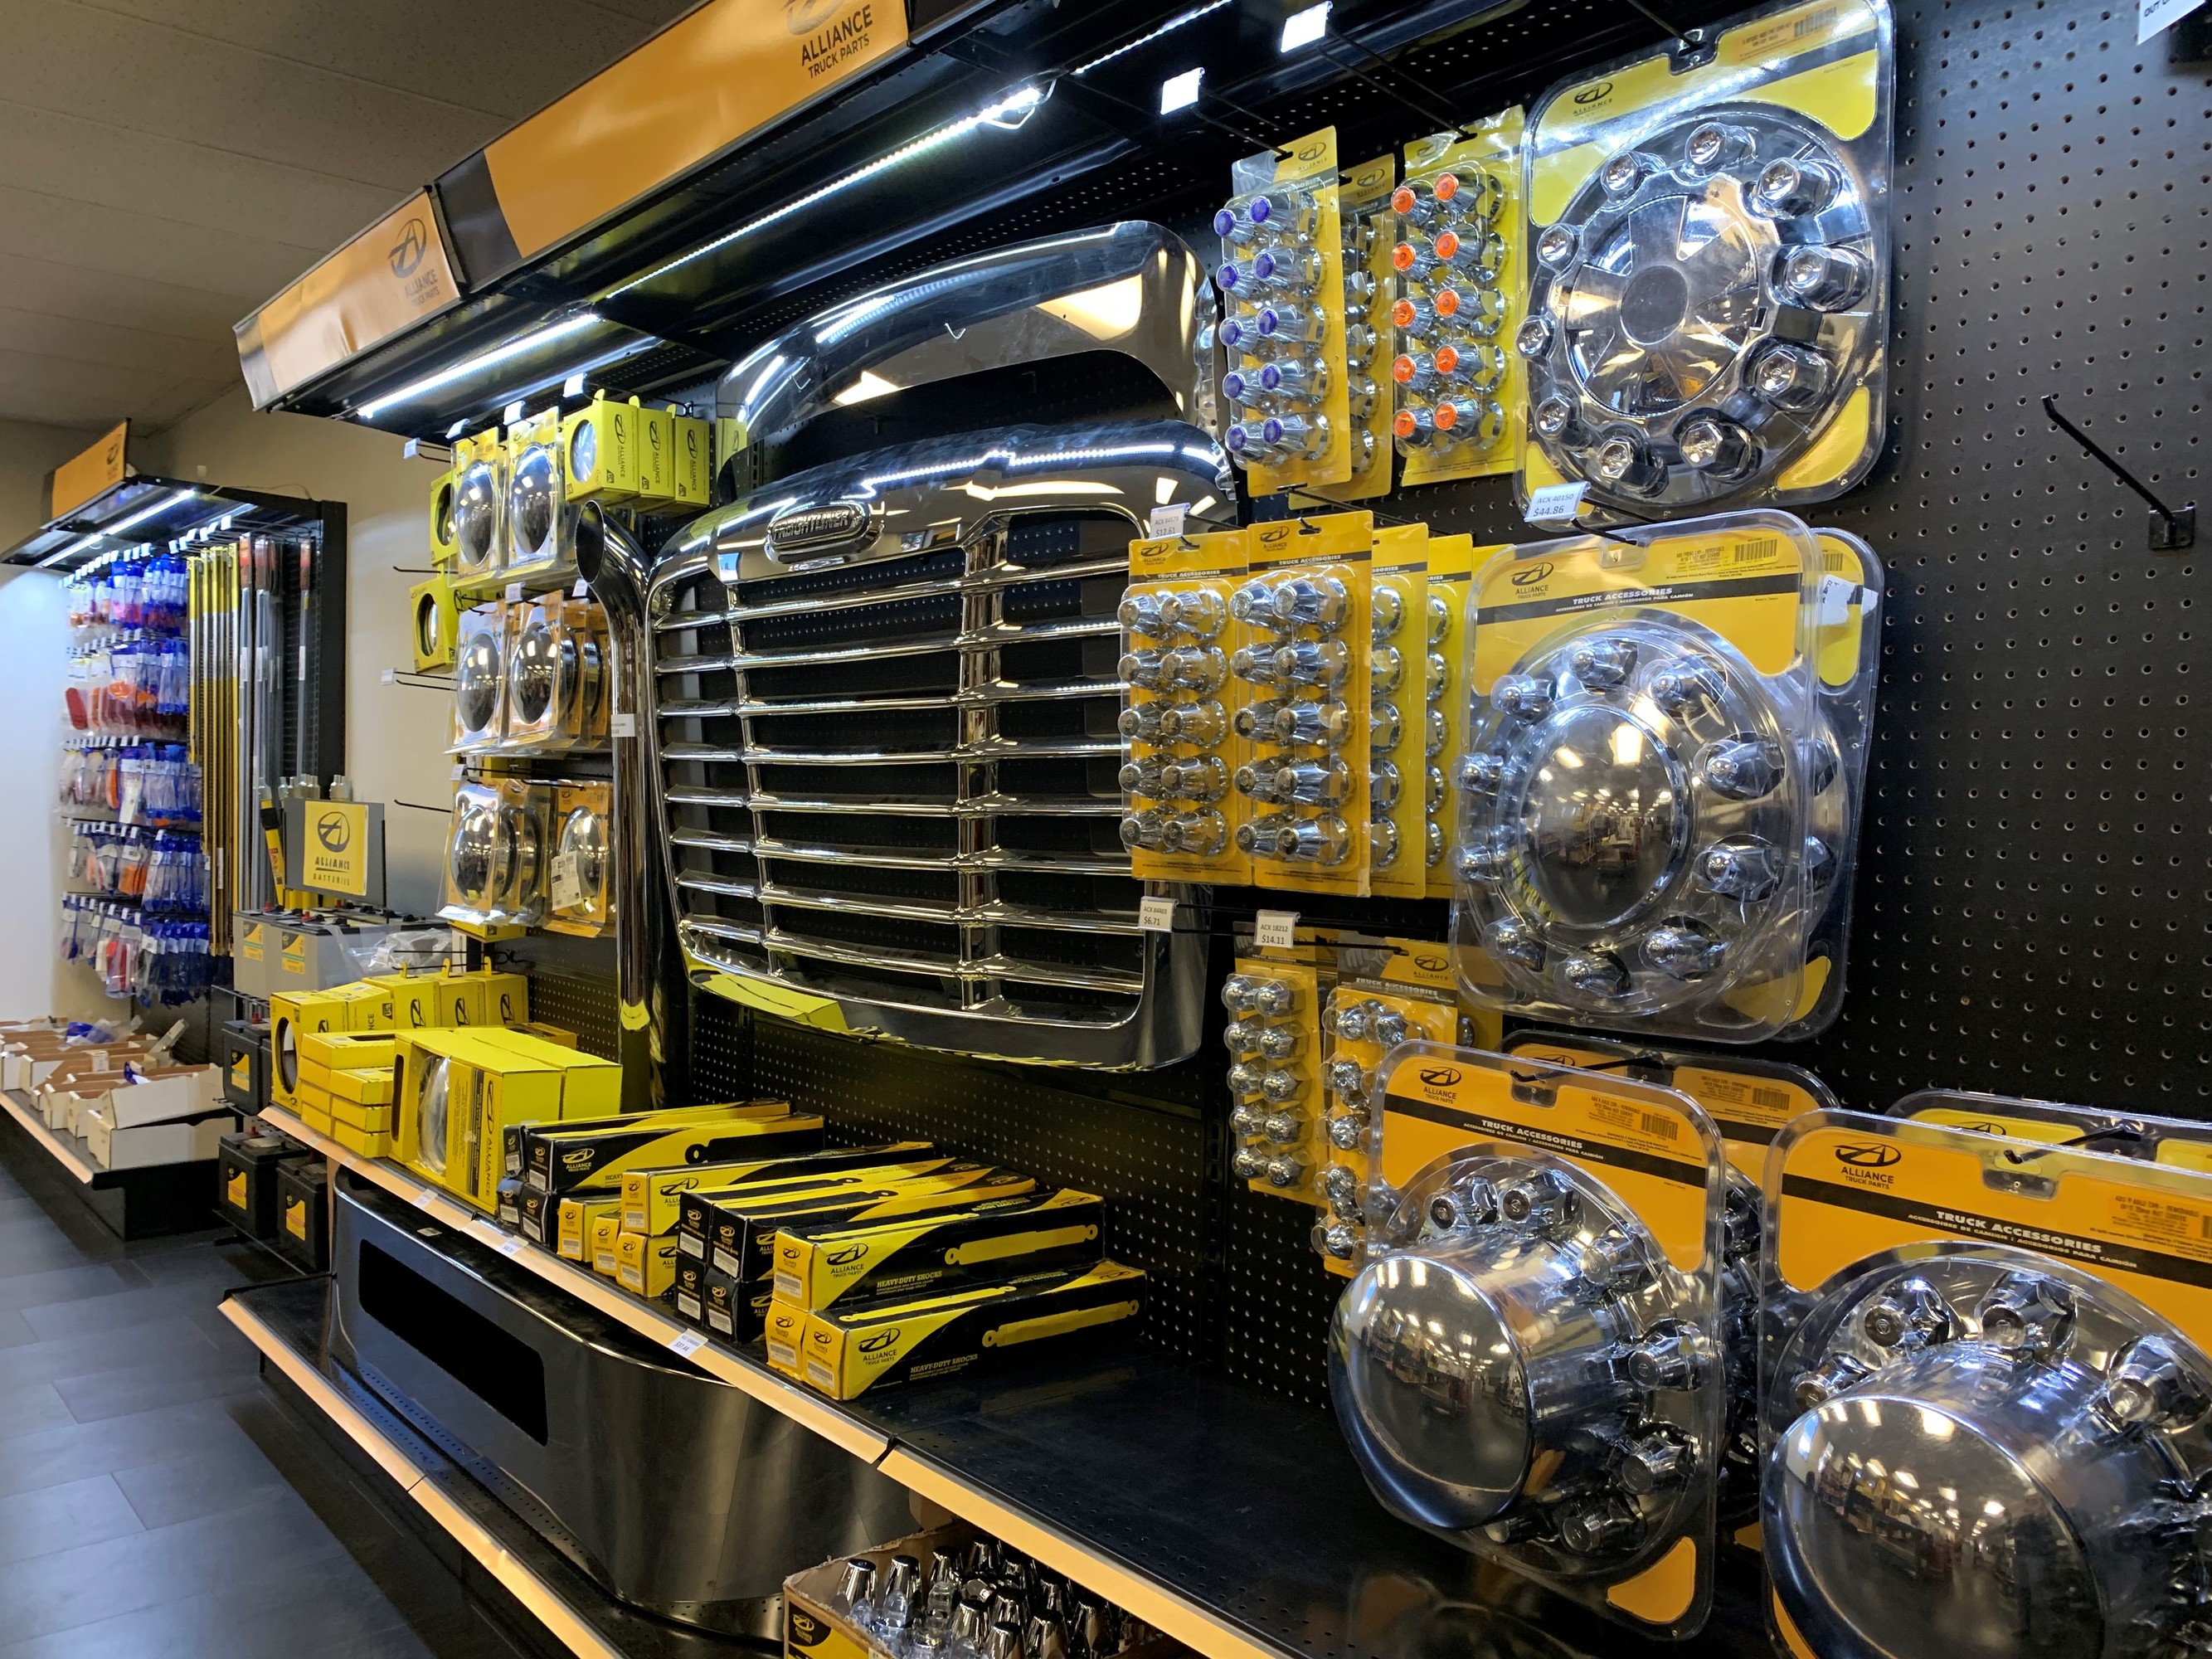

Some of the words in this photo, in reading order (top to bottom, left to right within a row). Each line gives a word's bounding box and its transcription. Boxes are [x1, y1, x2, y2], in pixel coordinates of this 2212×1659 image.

[801, 3, 873, 66] ALLIANCE
[808, 51, 839, 80] TRUCK
[839, 32, 870, 61] PARTS
[405, 268, 439, 298] ALLIANCE
[1533, 505, 1565, 517] $44.86
[1300, 555, 1342, 564] ACCESSORIES
[1179, 569, 1221, 578] ACCESSORIES
[1515, 584, 1549, 596] ALLIANCE
[1573, 595, 1602, 605] TRUCK
[1604, 587, 1673, 601] ACCESSORIES
[314, 856, 350, 870] ALLIANCE
[1144, 916, 1160, 926] $6.71
[1272, 924, 1289, 932] 18212
[1262, 934, 1285, 945] $14.11
[1413, 971, 1449, 980] ALLIANCE
[1423, 1086, 1457, 1100] ALLIANCE
[1481, 1119, 1514, 1133] TRUCK
[1516, 1128, 1583, 1150] ACCESSORIES
[566, 1161, 592, 1170] ALLIANCE
[1840, 1165, 1894, 1184] ALLIANCE
[1845, 1175, 1867, 1185] TRUCK
[1868, 1180, 1890, 1190] PARTS
[1936, 1210, 1987, 1229] TRUCK
[1991, 1223, 2103, 1254] ACCESSORIES
[830, 1262, 865, 1275] ALLIANCE
[876, 1275, 916, 1288] HEAVY-DUTY
[916, 1270, 943, 1282] SHOCKS
[863, 1349, 897, 1362] ALLIANCE
[910, 1359, 952, 1374] HEAVY-DUTY
[951, 1353, 979, 1365] SHOCKS
